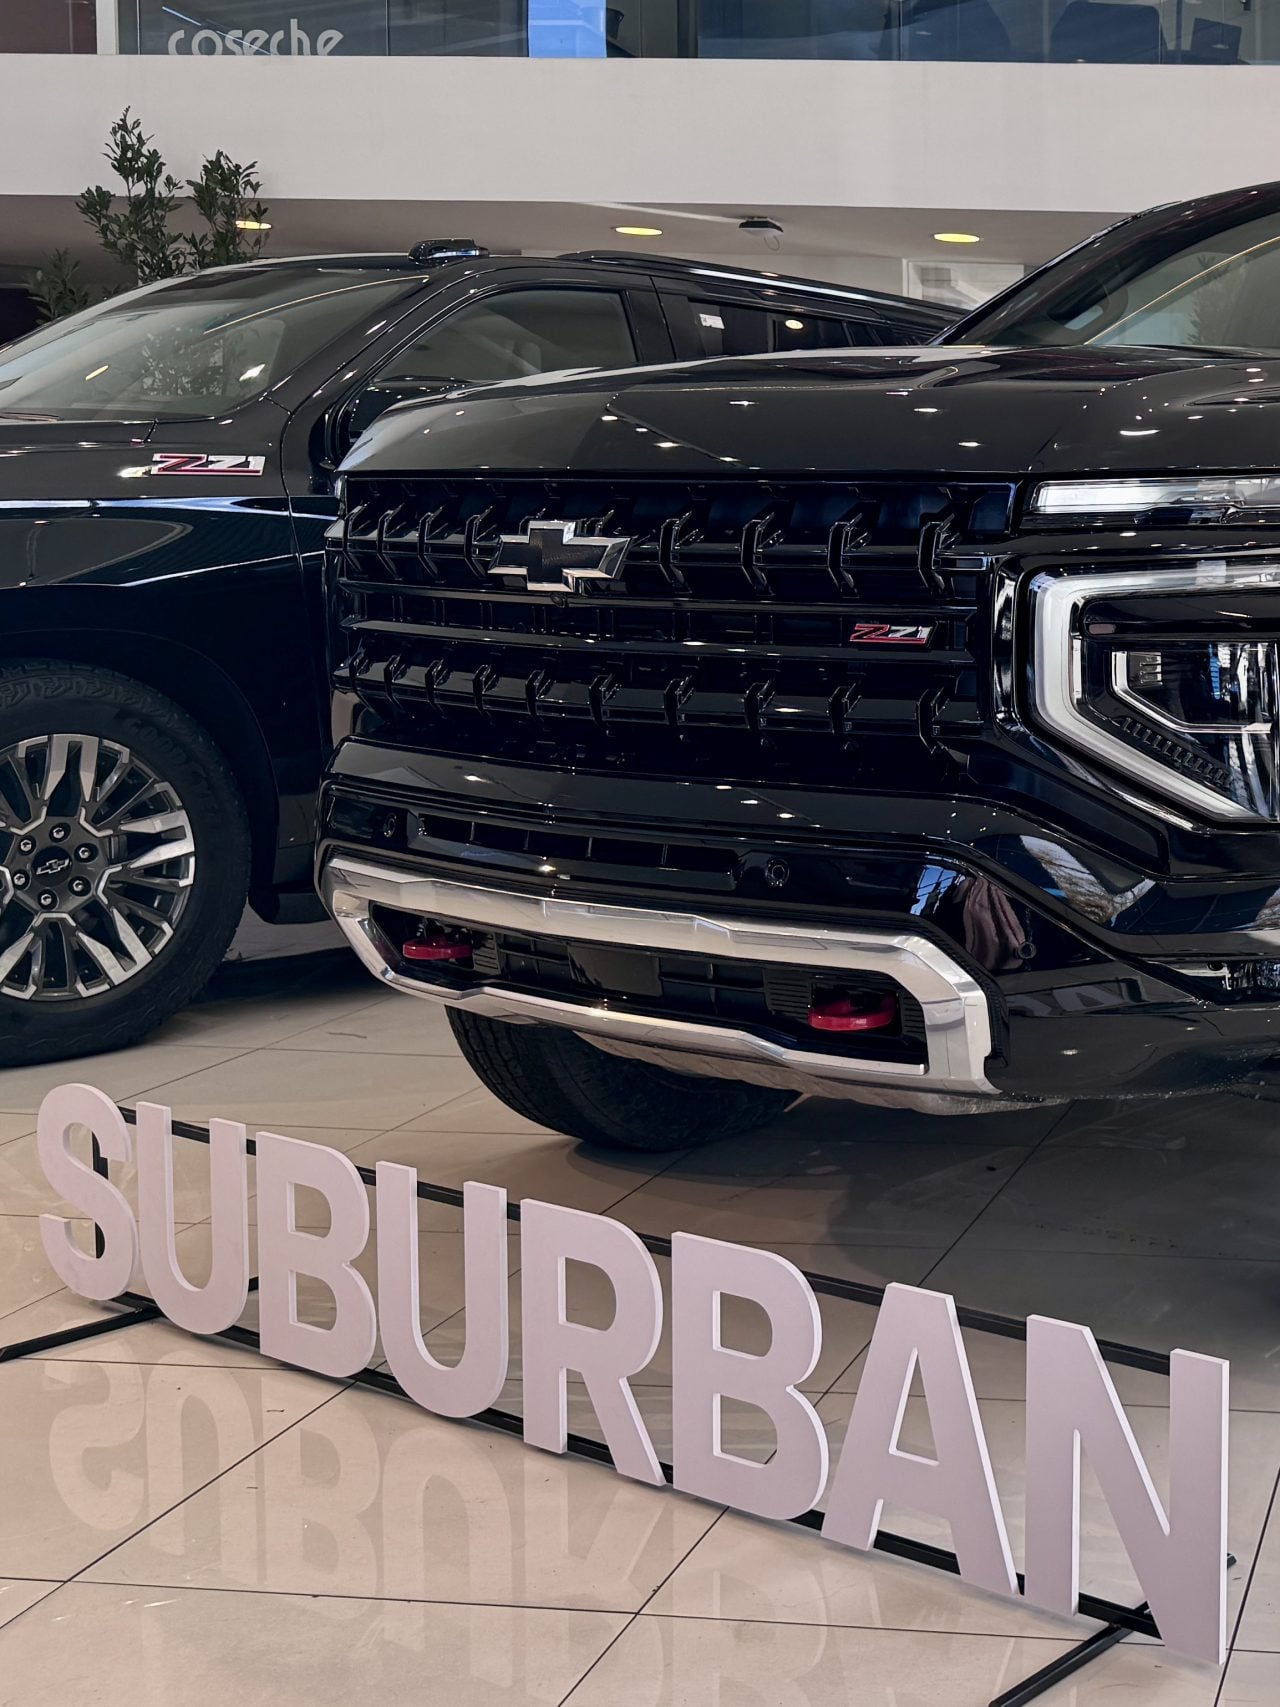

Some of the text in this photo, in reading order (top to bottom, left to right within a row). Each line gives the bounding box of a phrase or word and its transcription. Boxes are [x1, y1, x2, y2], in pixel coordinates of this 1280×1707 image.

[168, 18, 344, 55] coseche
[150, 453, 266, 477] Z71
[849, 623, 933, 644] Z71
[39, 1083, 1229, 1665] SUBURBAN
